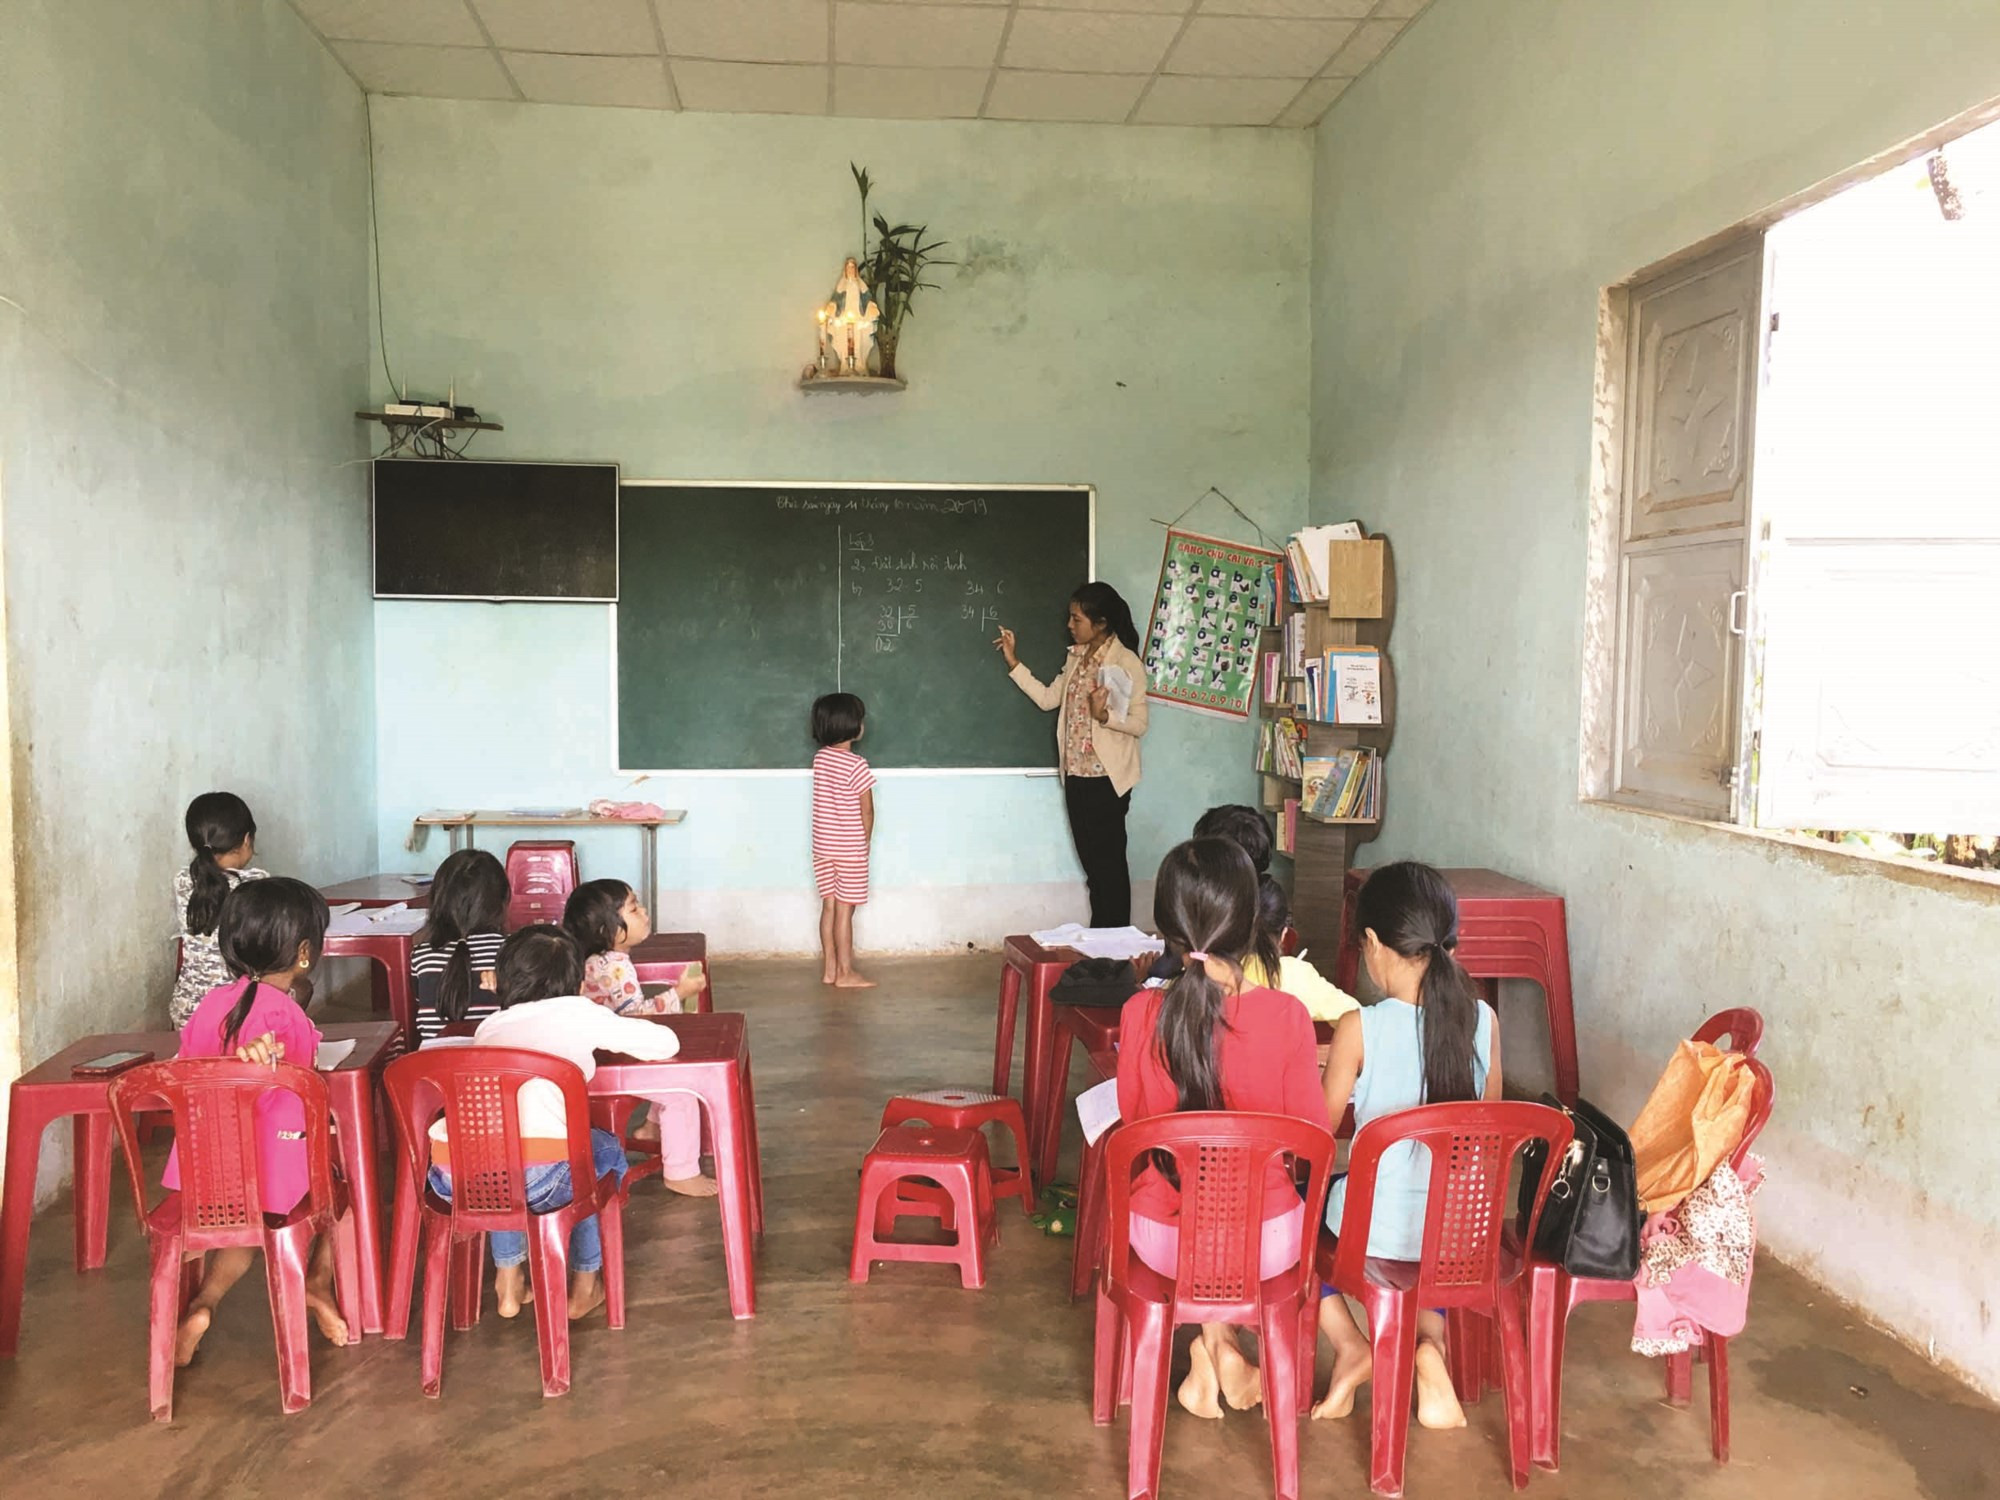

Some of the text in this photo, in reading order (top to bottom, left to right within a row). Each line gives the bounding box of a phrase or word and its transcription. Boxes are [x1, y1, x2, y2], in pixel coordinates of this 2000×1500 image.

[1211, 565, 1221, 578] â
[1233, 570, 1243, 583] b
[1159, 598, 1168, 610] h
[1201, 607, 1210, 619] k
[1206, 590, 1215, 599] e
[1229, 591, 1238, 603] ê
[1249, 596, 1259, 609] g
[1154, 621, 1164, 631] n
[1176, 626, 1185, 635] o
[1197, 627, 1207, 640] ô
[1240, 638, 1250, 649] p
[1151, 639, 1161, 650] q
[1192, 646, 1200, 656] s
[1215, 652, 1222, 663] t
[1188, 665, 1198, 676] x
[1211, 670, 1220, 683] y
[1162, 684, 1168, 692] 3
[1171, 686, 1178, 695] 4
[1181, 688, 1188, 697] 5
[1190, 690, 1197, 699] 6
[1200, 692, 1207, 701] 7
[1210, 694, 1217, 703] 8
[1219, 696, 1227, 705] 9
